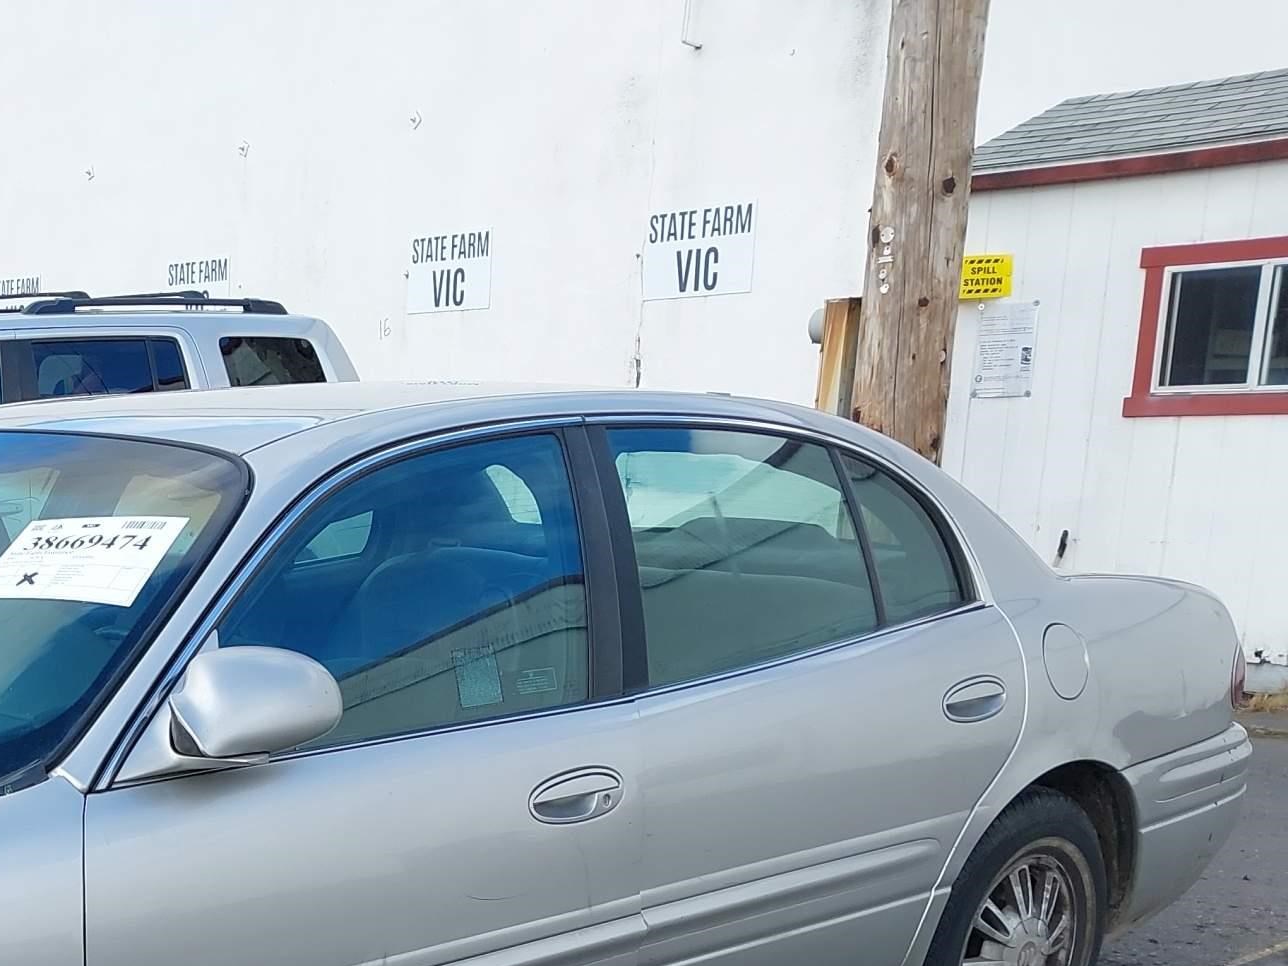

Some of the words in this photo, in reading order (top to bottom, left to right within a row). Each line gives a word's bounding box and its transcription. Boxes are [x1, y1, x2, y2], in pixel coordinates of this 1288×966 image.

[649, 210, 699, 244] STATE
[702, 203, 753, 237] FARM
[412, 235, 448, 264] STATE
[451, 231, 490, 260] FARM
[168, 261, 197, 287] STATE
[198, 258, 228, 284] FARM
[676, 246, 719, 293] VIC
[963, 277, 1003, 287] STATION
[970, 266, 998, 275] SPILL
[432, 267, 466, 308] VIC
[23, 534, 152, 551] 38669474
